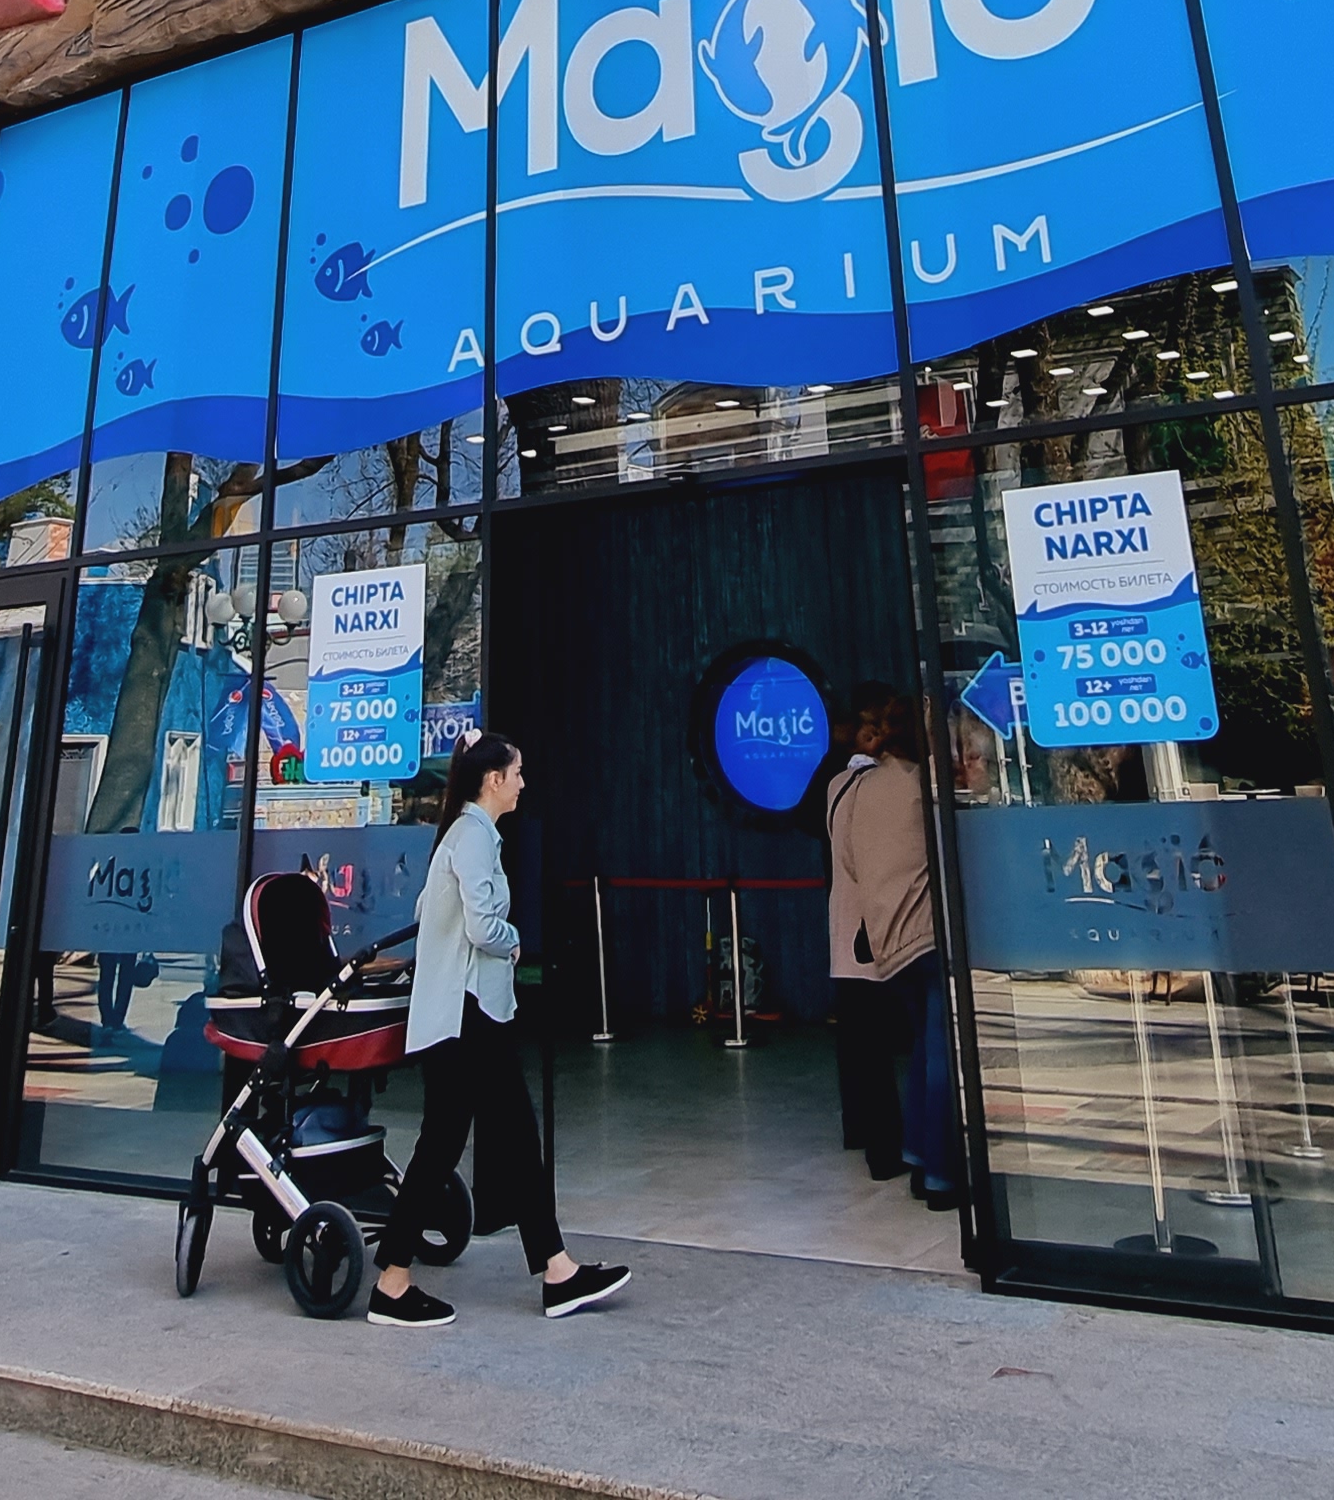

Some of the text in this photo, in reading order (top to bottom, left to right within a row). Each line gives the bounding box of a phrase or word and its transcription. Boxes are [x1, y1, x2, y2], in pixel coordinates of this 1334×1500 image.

[448, 215, 1052, 374] AQUARIUM
[1033, 492, 1153, 528] CHIPTA
[1043, 526, 1150, 562] NARXI
[331, 580, 405, 607] CHIPTA
[1033, 572, 1174, 596] СТОИМОСТЬ БИЛЕТА
[334, 608, 400, 634] NARXI
[1073, 621, 1109, 636] 3-12
[322, 645, 409, 661] СТОИМОСТЬ БИЛЕТА
[1056, 638, 1167, 669] 75 000
[1085, 679, 1113, 694] 12+
[329, 698, 397, 722] 75 000
[1054, 695, 1187, 727] 100 000
[735, 707, 814, 746] Magic
[320, 745, 357, 768] 100
[361, 743, 403, 766] 000
